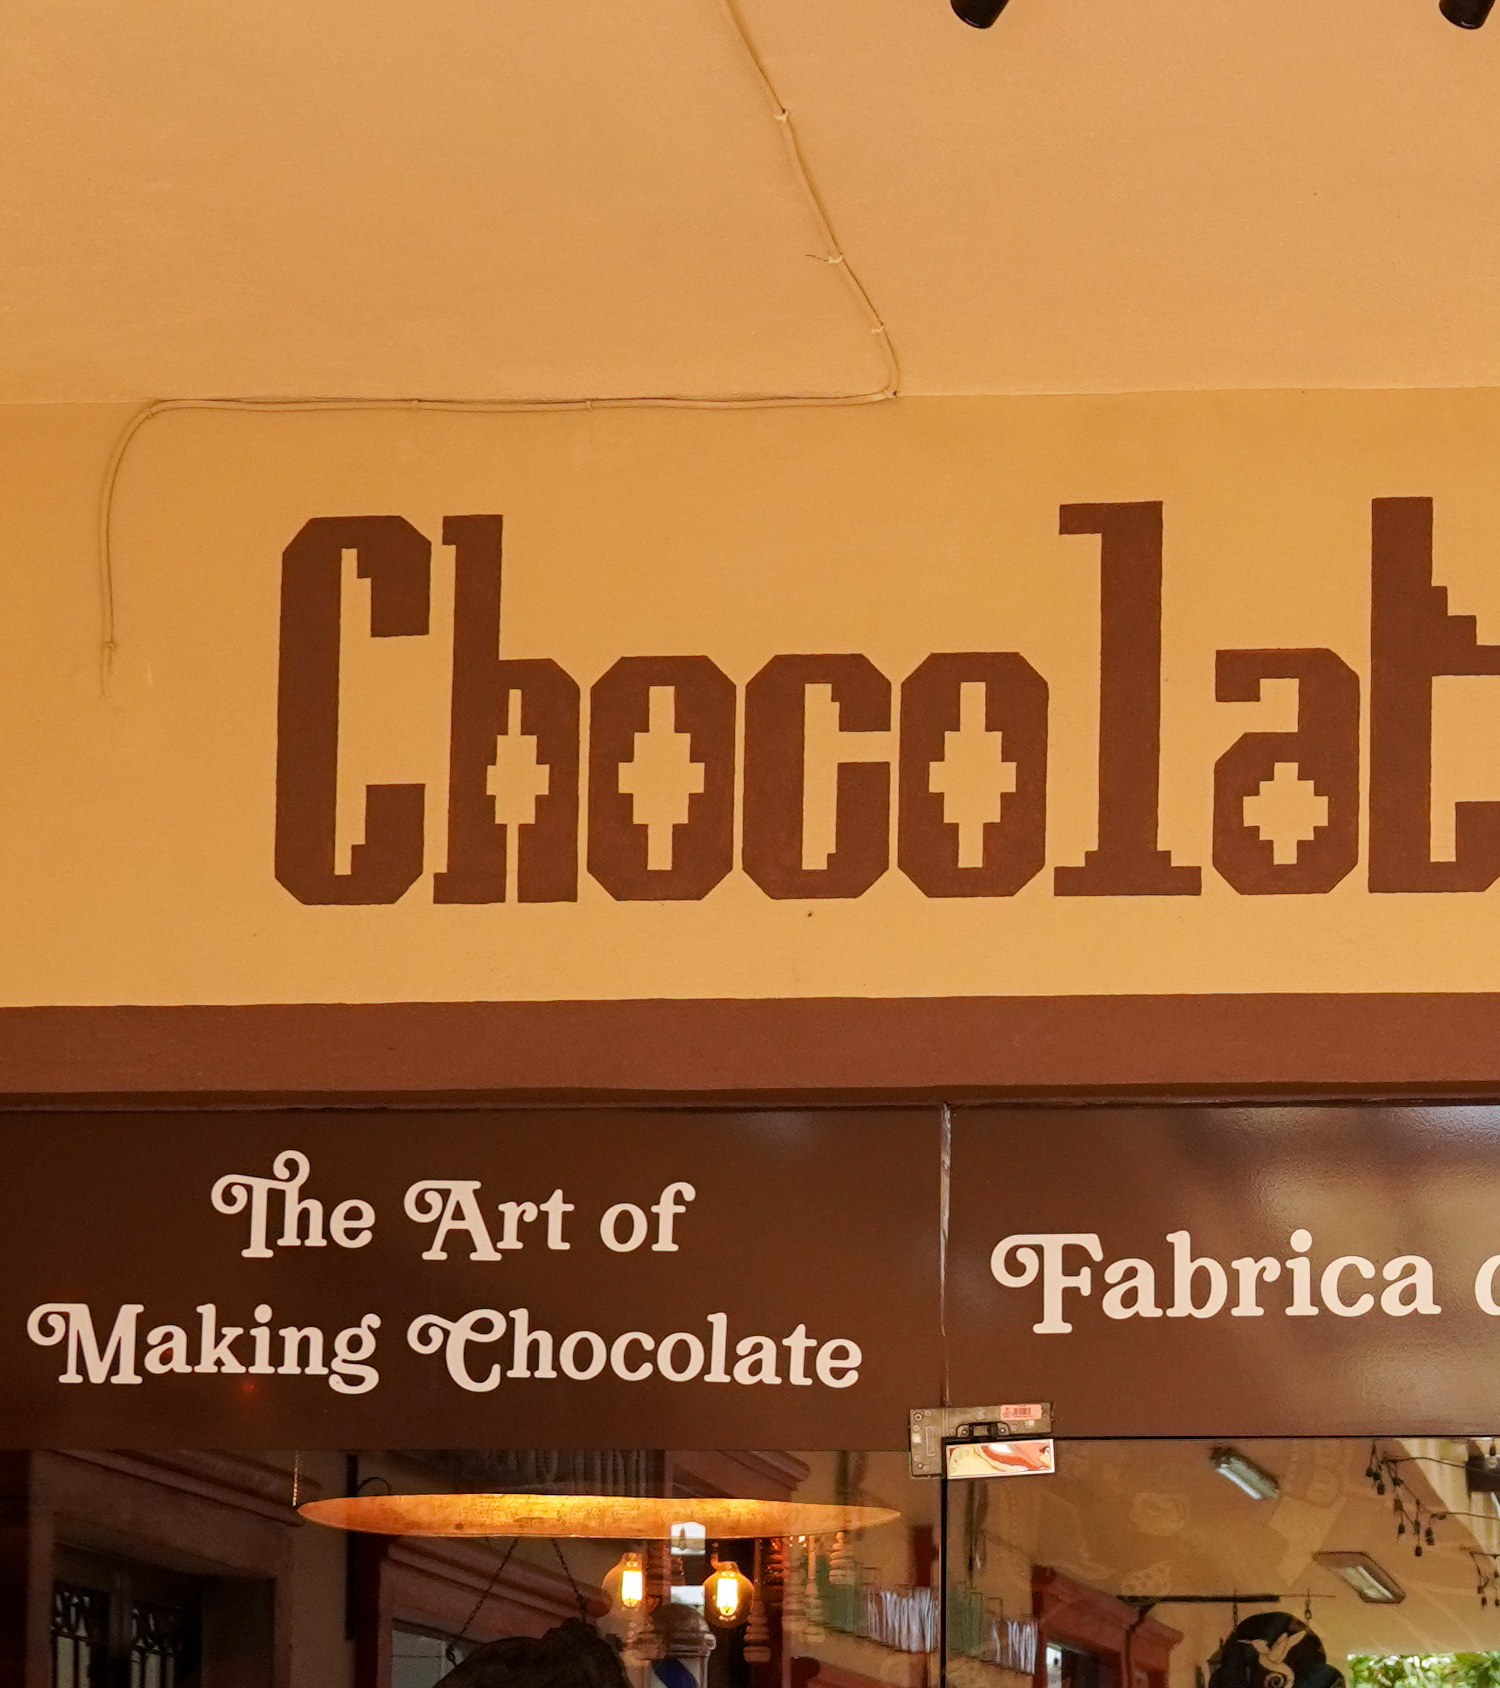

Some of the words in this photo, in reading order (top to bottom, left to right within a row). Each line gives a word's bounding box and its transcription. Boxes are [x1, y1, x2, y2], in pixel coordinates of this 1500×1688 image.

[211, 1150, 376, 1258] The
[404, 1180, 574, 1262] Art
[600, 1182, 696, 1252] of
[990, 1228, 1442, 1335] Fabrica
[27, 1304, 380, 1394] Making
[407, 1308, 863, 1393] Chocolate
